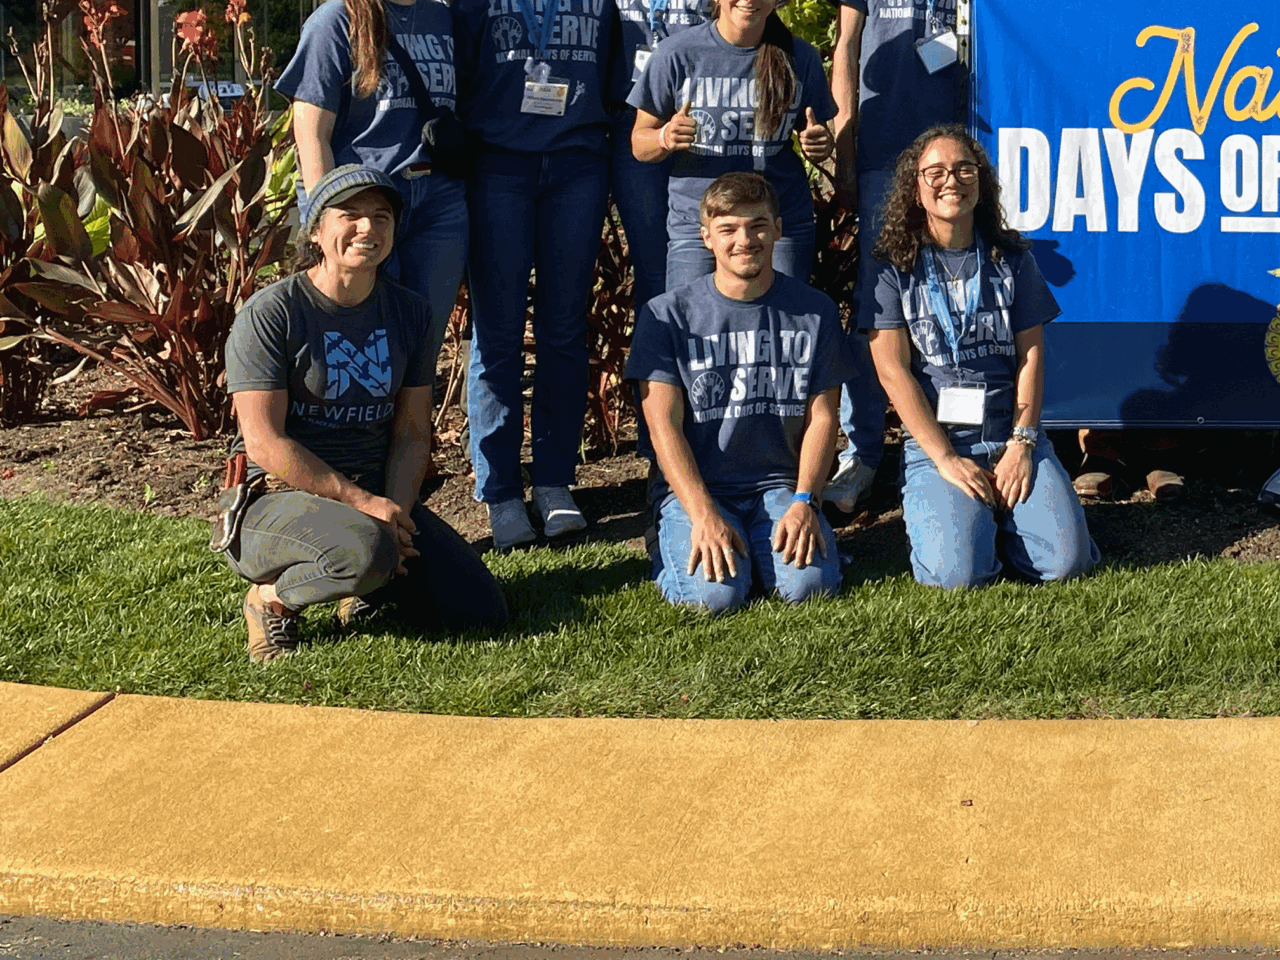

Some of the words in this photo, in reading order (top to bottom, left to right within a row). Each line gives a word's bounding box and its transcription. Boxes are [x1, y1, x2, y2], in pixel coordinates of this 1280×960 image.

[528, 14, 600, 50] ERVE
[998, 128, 1206, 233] DAYS
[687, 329, 771, 372] LIVING
[780, 330, 811, 364] TO
[959, 348, 978, 361] AYS
[730, 366, 810, 401] SERVE
[693, 406, 732, 424] NATIONAL
[734, 404, 754, 418] DAYS
[755, 401, 767, 415] OF
[768, 403, 806, 417] SERVICE
